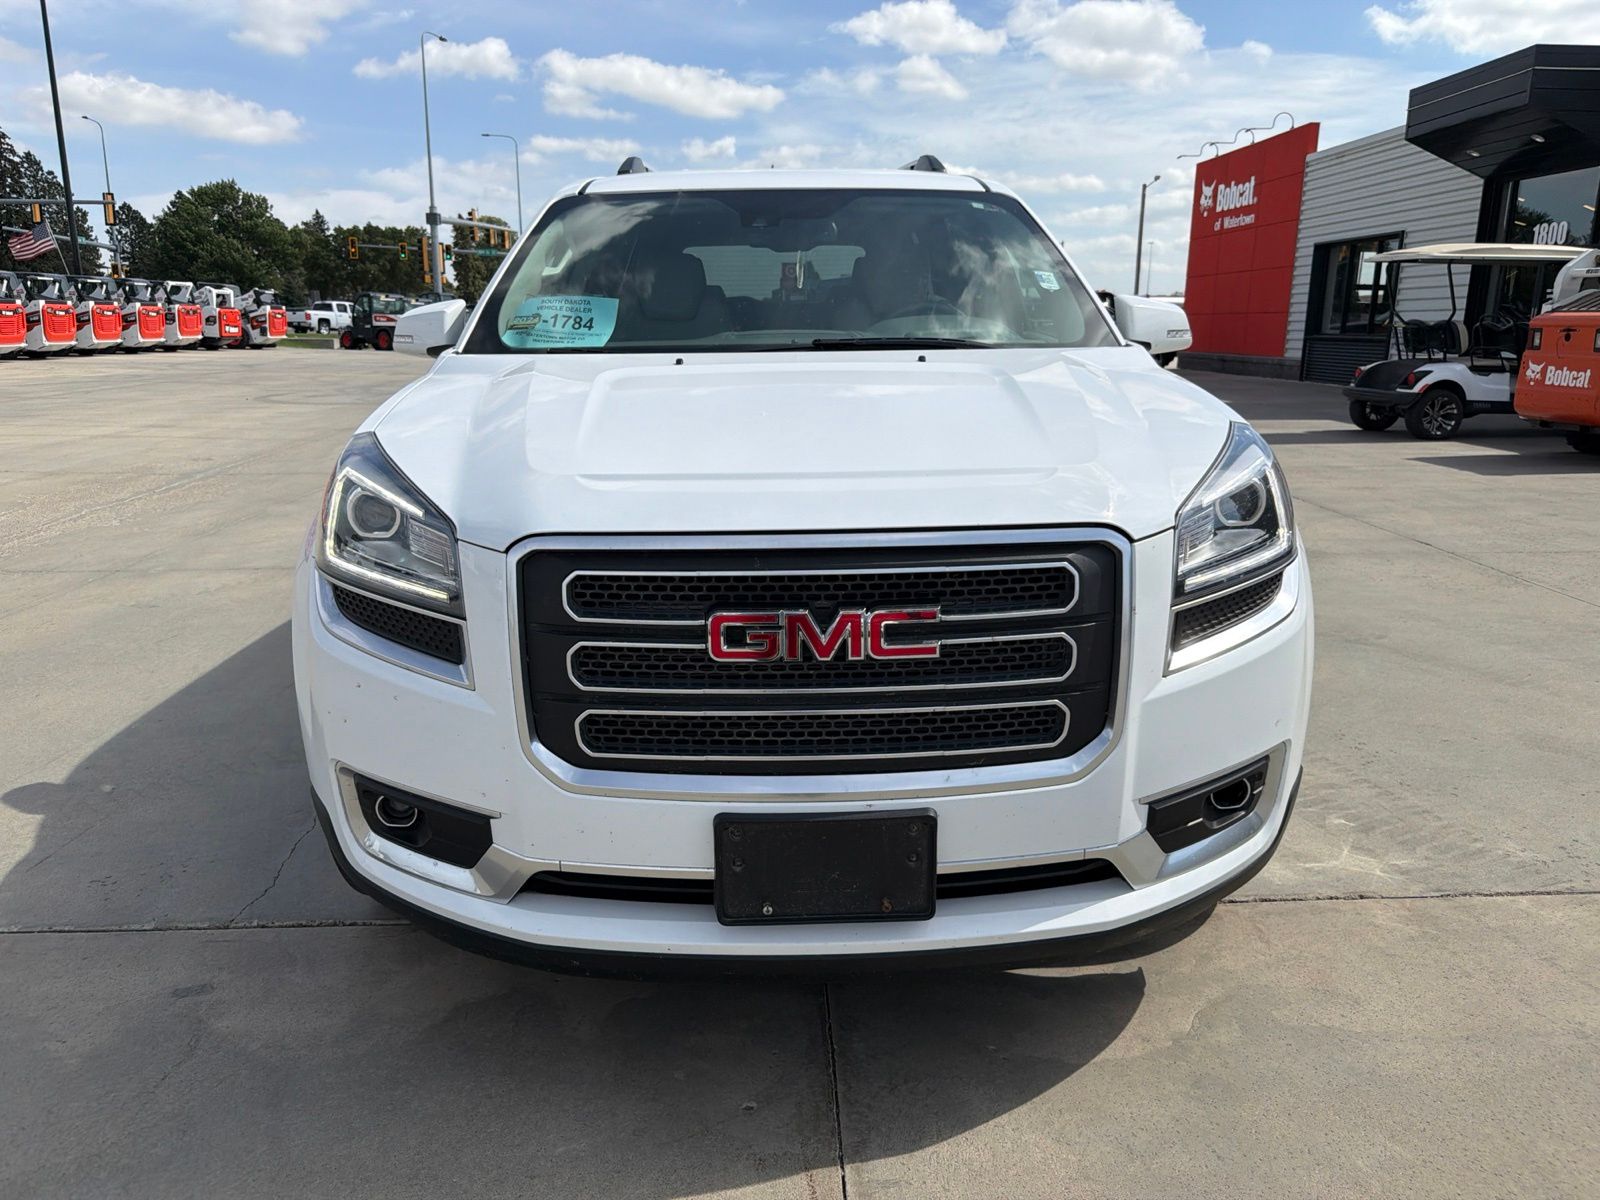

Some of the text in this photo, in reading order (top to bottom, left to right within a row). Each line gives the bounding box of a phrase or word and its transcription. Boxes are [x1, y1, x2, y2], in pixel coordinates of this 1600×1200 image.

[1216, 176, 1256, 212] Bobcat
[1214, 218, 1222, 231] of
[1533, 221, 1568, 245] 1800
[1545, 365, 1591, 388] Bobcat
[707, 605, 941, 662] GMC
